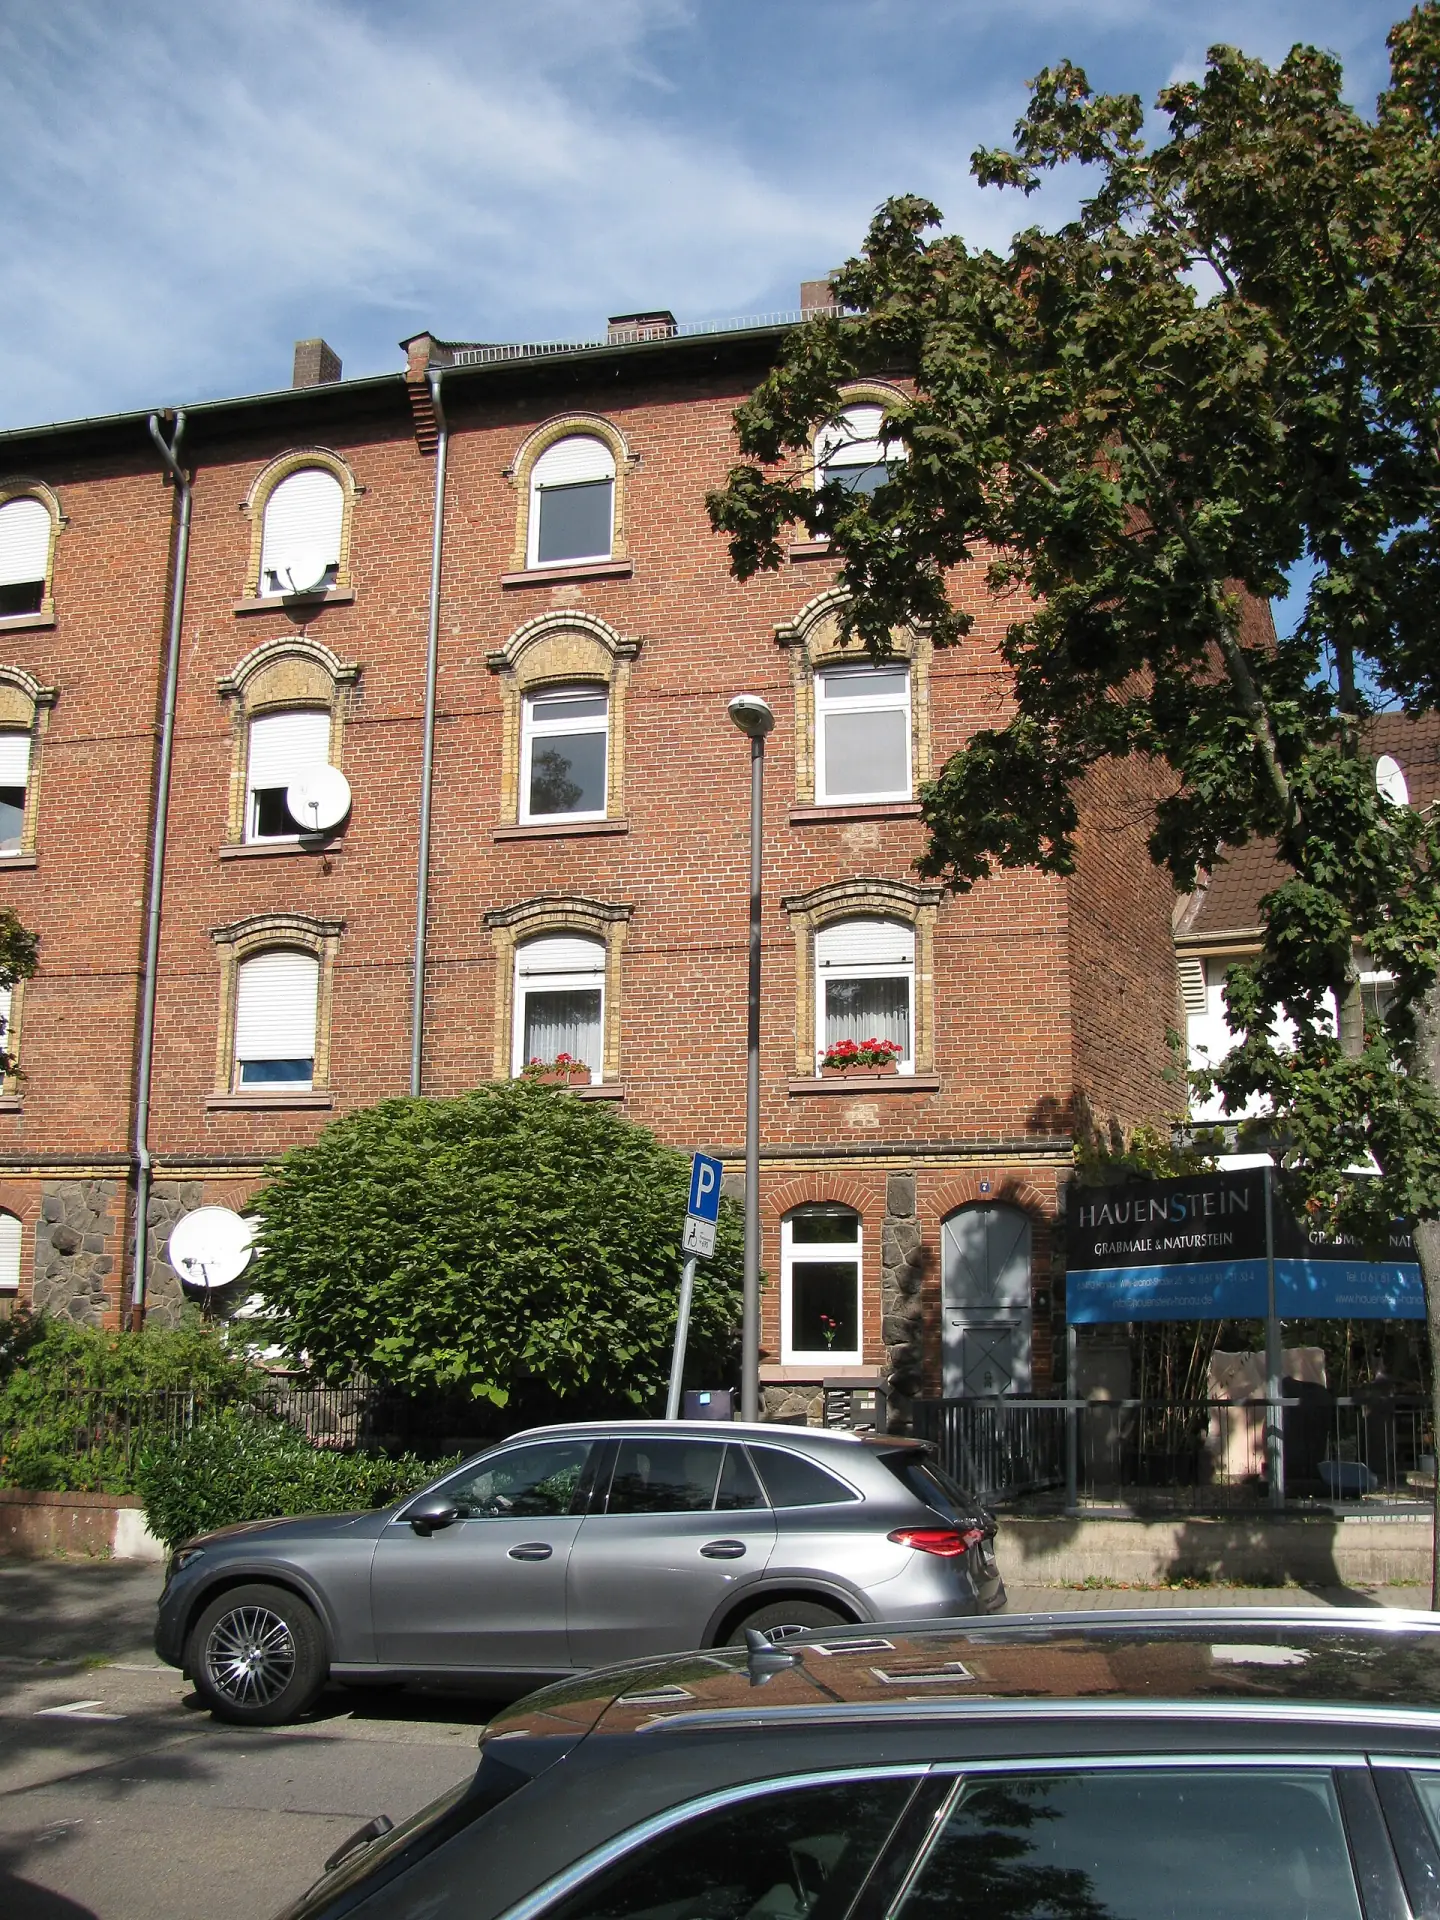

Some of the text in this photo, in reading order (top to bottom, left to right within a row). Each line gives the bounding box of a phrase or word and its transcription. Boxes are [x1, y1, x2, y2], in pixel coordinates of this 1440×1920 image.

[696, 1163, 715, 1208] P
[1079, 1182, 1249, 1228] HAUENSTEIN
[1094, 1232, 1233, 1256] GRABMALE & NATURSTEIN
